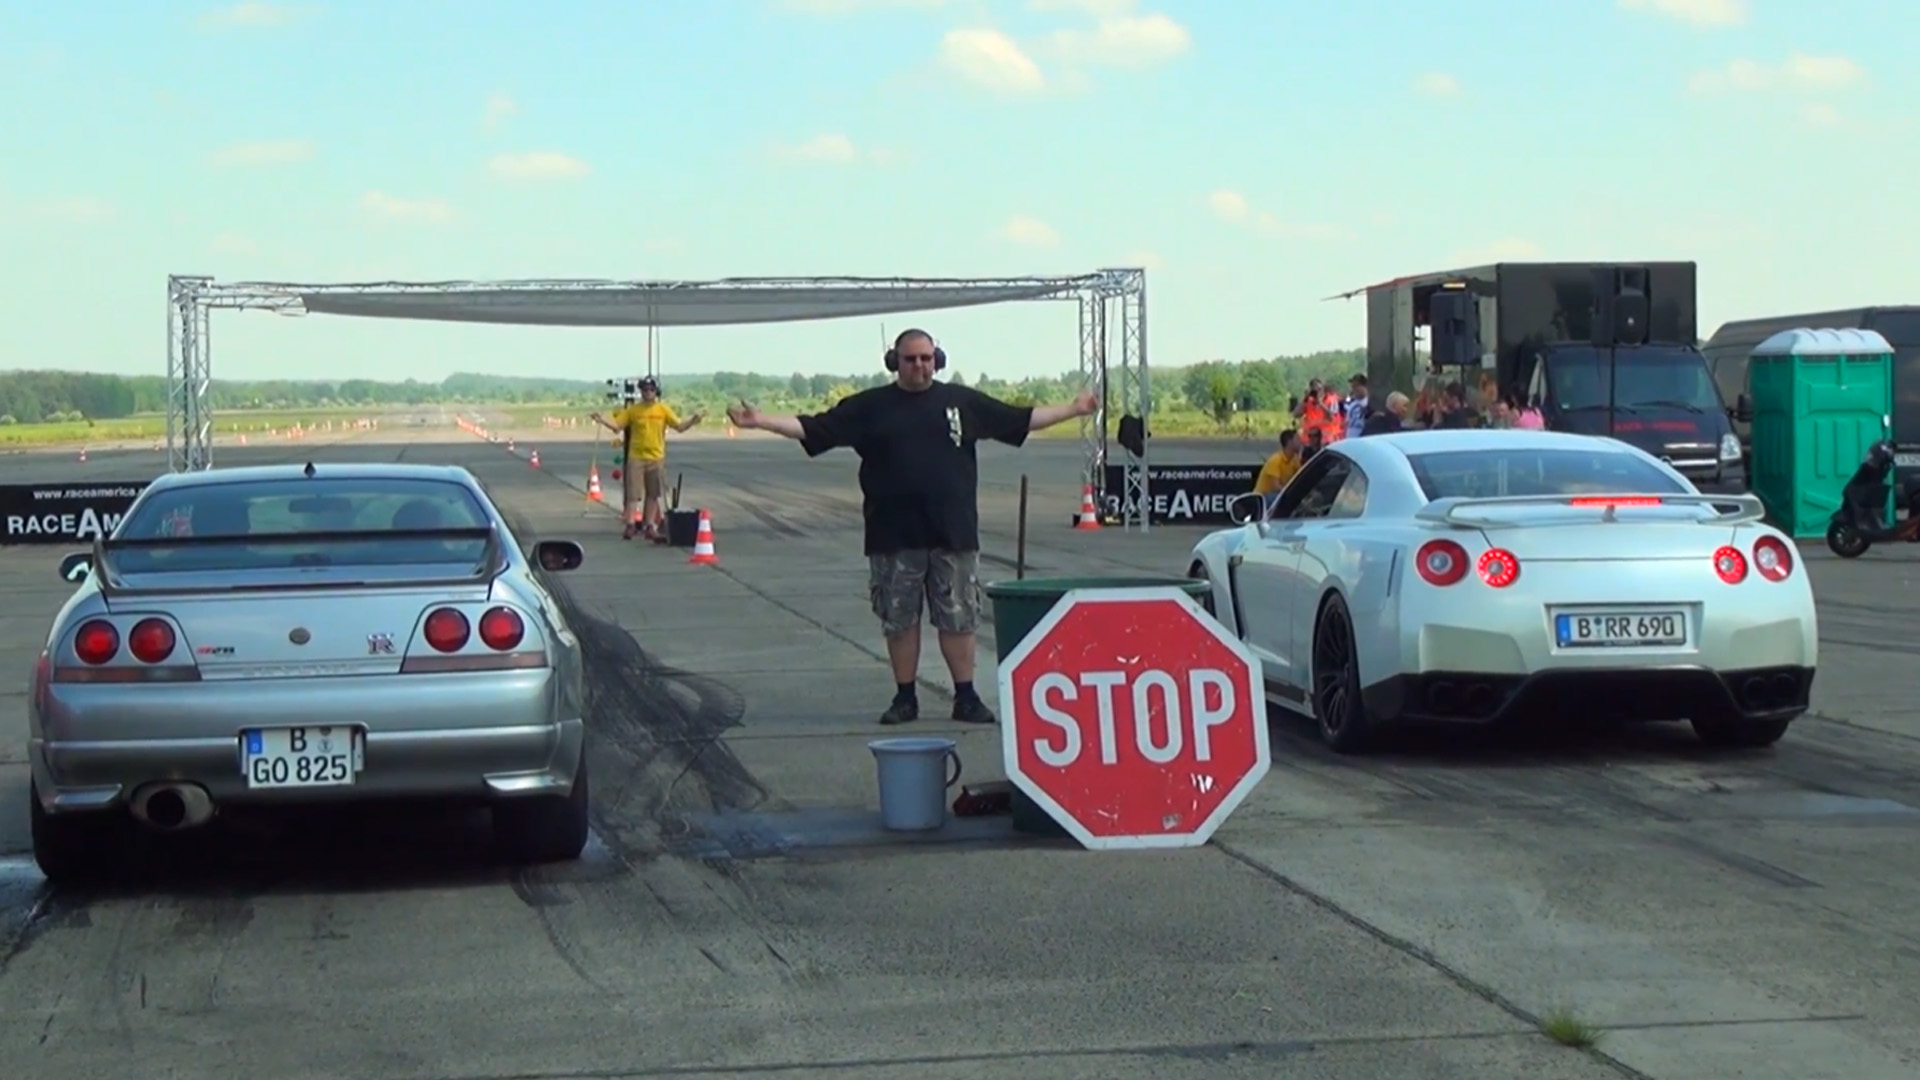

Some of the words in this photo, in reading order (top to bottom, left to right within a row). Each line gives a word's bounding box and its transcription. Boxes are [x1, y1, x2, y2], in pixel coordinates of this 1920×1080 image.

[1578, 618, 1591, 638] B
[1605, 617, 1631, 637] RR
[1637, 616, 1674, 637] 690
[1031, 668, 1236, 767] STOP
[290, 727, 307, 752] B
[253, 756, 289, 783] GO
[296, 754, 347, 782] 825
